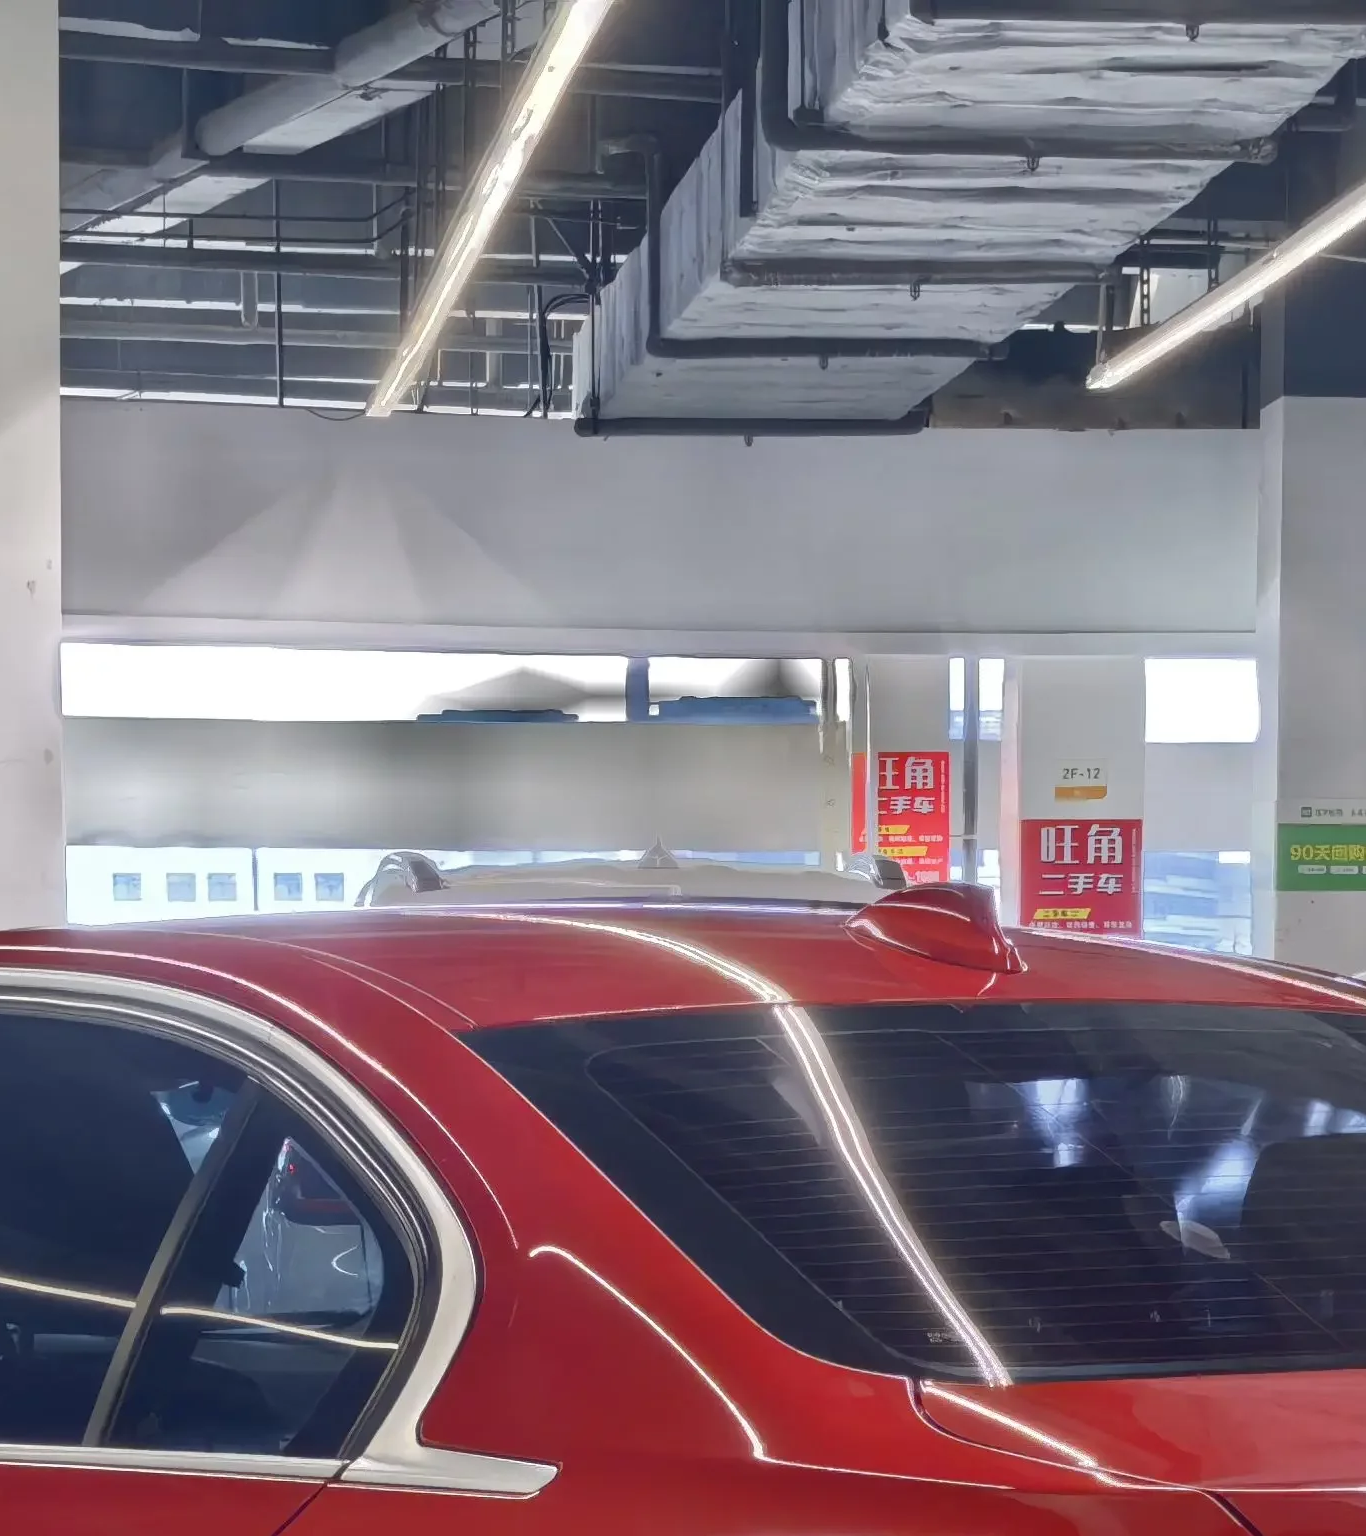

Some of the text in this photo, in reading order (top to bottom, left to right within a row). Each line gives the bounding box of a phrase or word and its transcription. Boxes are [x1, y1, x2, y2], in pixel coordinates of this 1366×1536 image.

[1062, 767, 1101, 780] 2F-12
[1039, 823, 1124, 865] 旺角
[1038, 873, 1124, 895] 二手车
